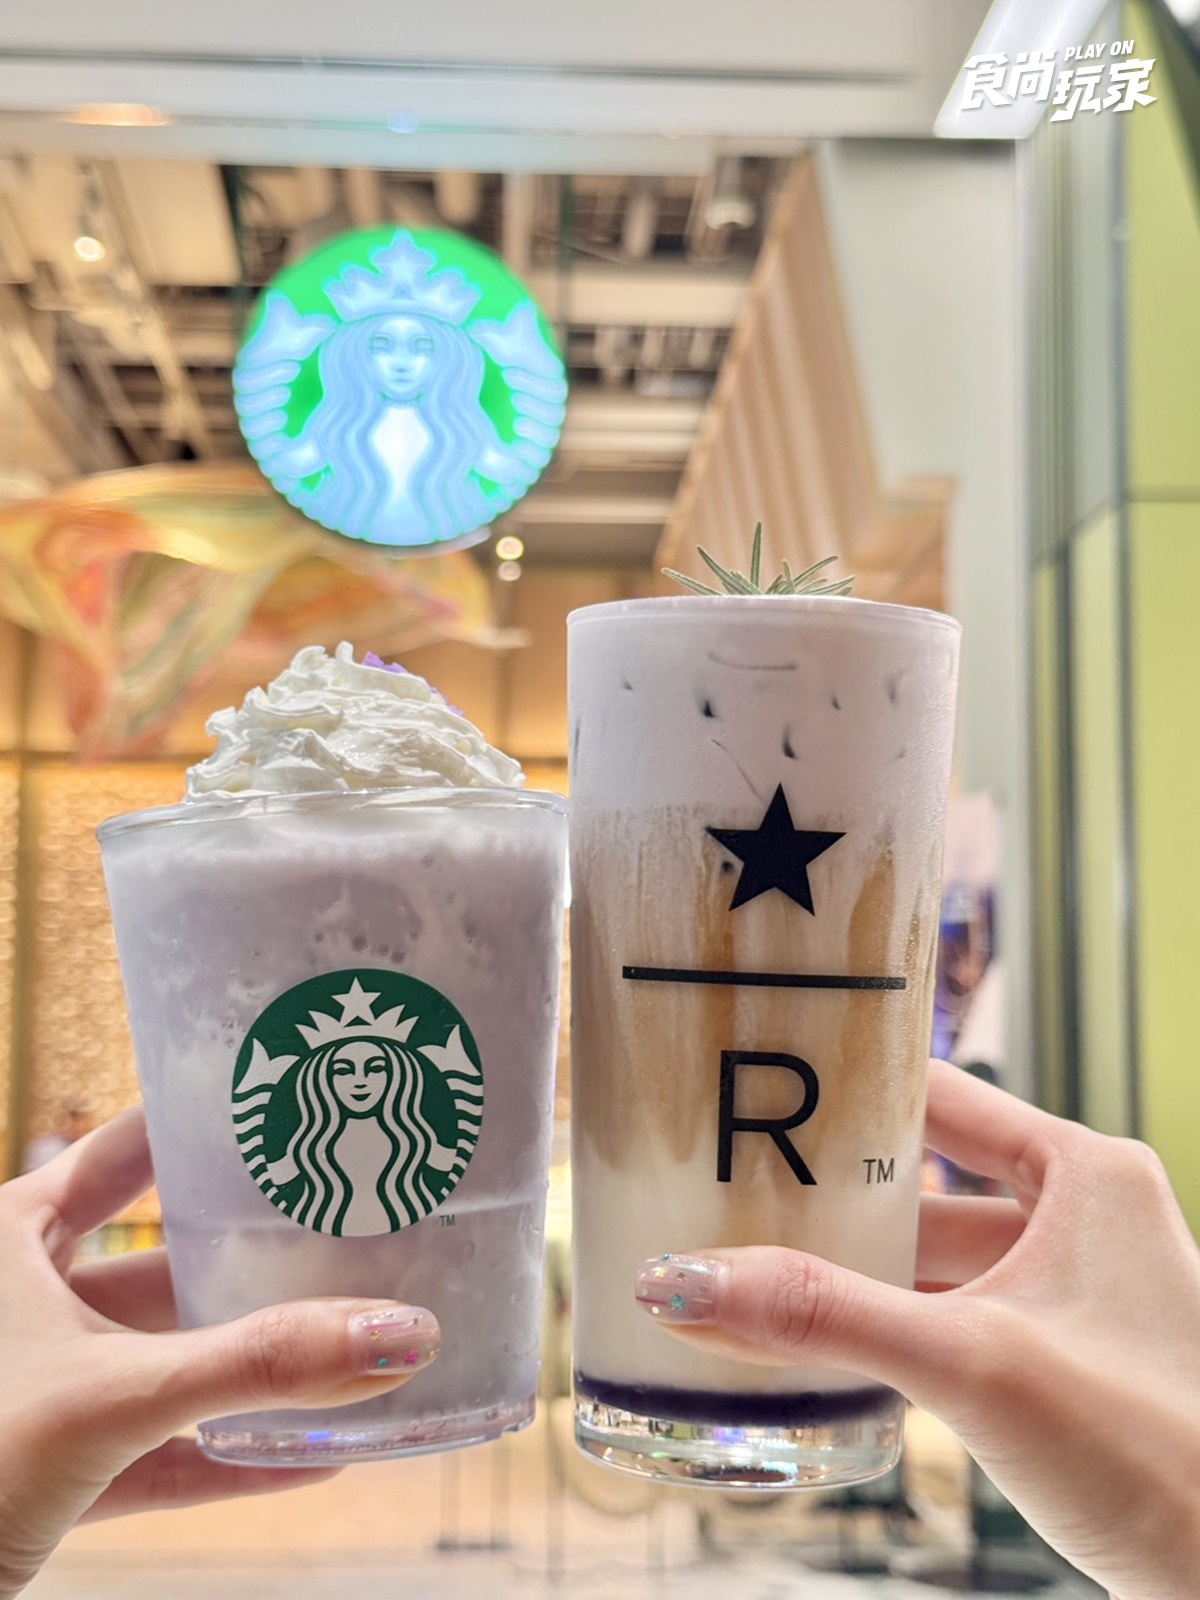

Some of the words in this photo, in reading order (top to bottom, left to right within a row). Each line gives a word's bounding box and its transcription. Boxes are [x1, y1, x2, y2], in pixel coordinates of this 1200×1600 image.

[717, 1050, 819, 1185] R
[862, 1158, 895, 1184] TM
[439, 1214, 455, 1227] TM
